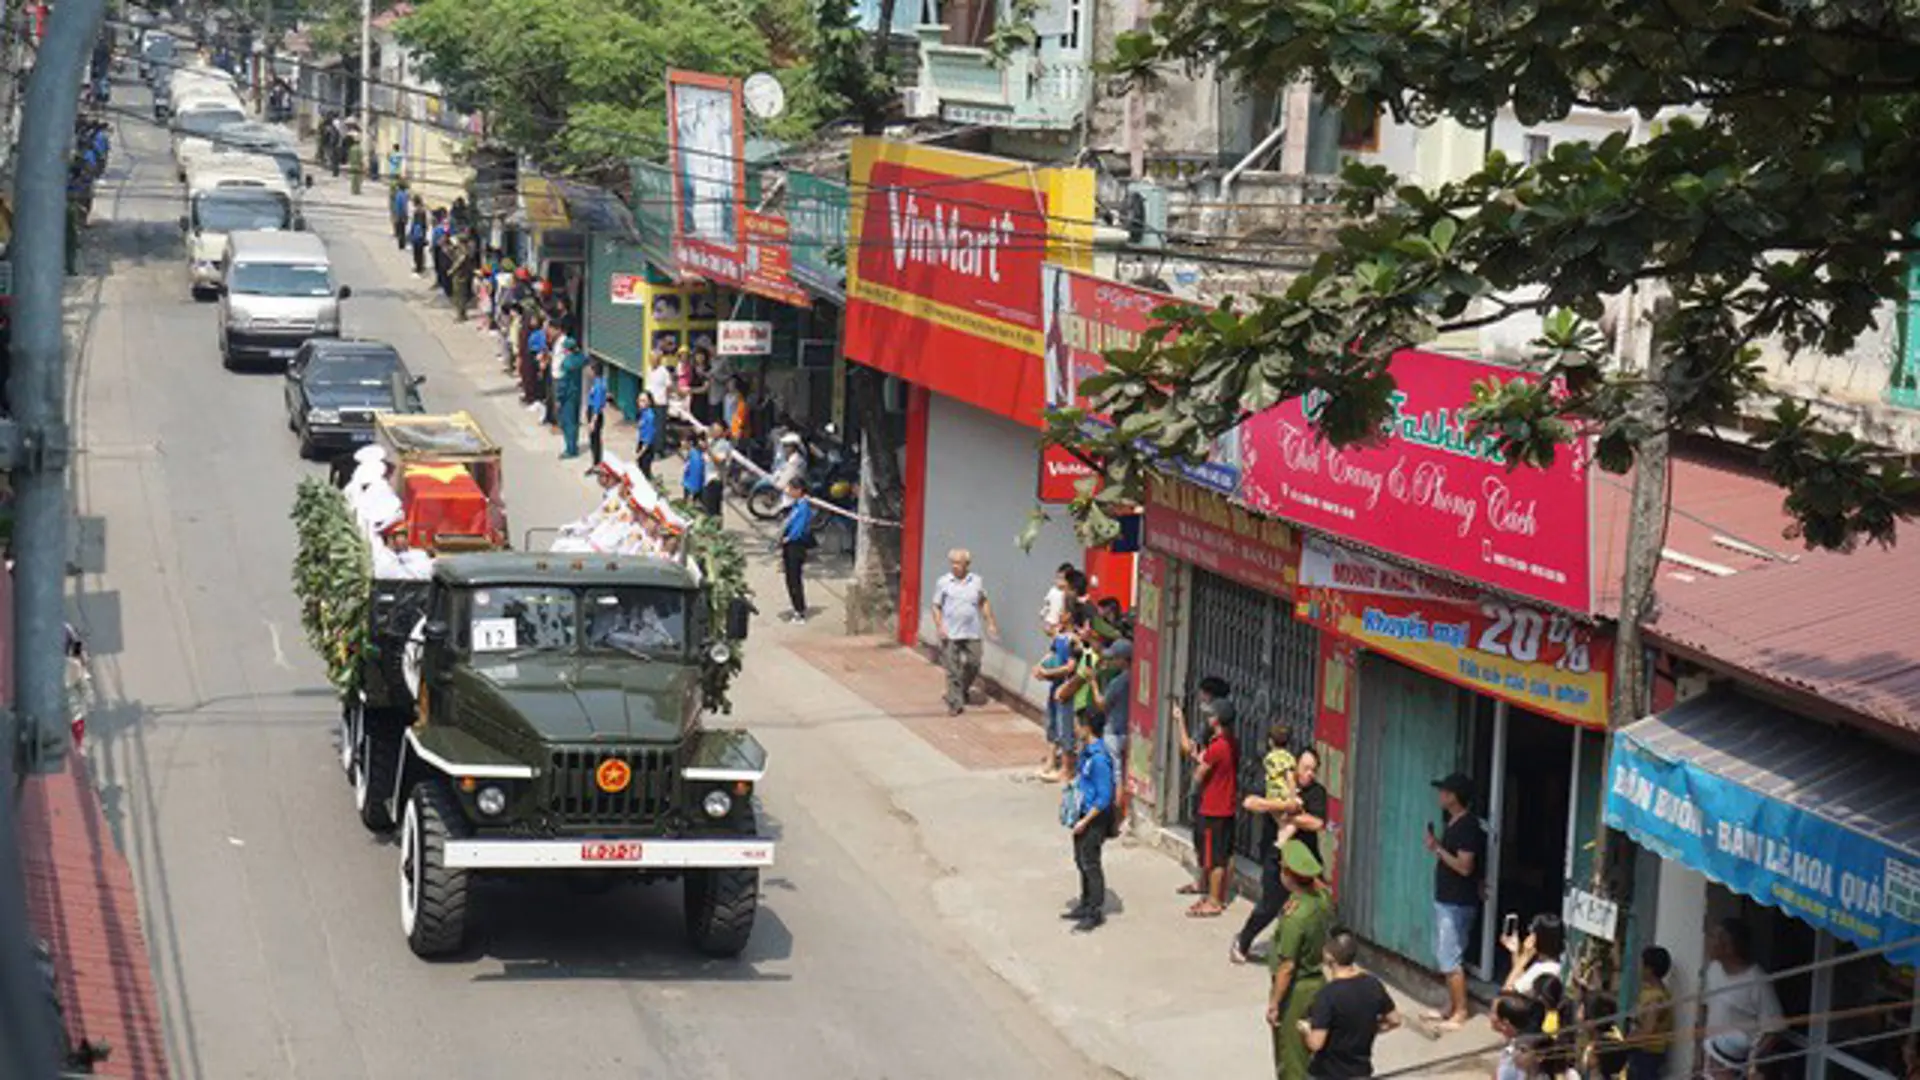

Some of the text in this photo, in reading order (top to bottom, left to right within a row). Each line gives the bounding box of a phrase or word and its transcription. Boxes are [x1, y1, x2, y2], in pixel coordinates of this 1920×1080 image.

[1413, 460, 1477, 538] Phong
[1482, 475, 1538, 538] Cách
[484, 629, 506, 646] 12
[1478, 604, 1591, 674] 20%
[1717, 819, 1763, 865] BÁN
[1792, 850, 1834, 898] HOA
